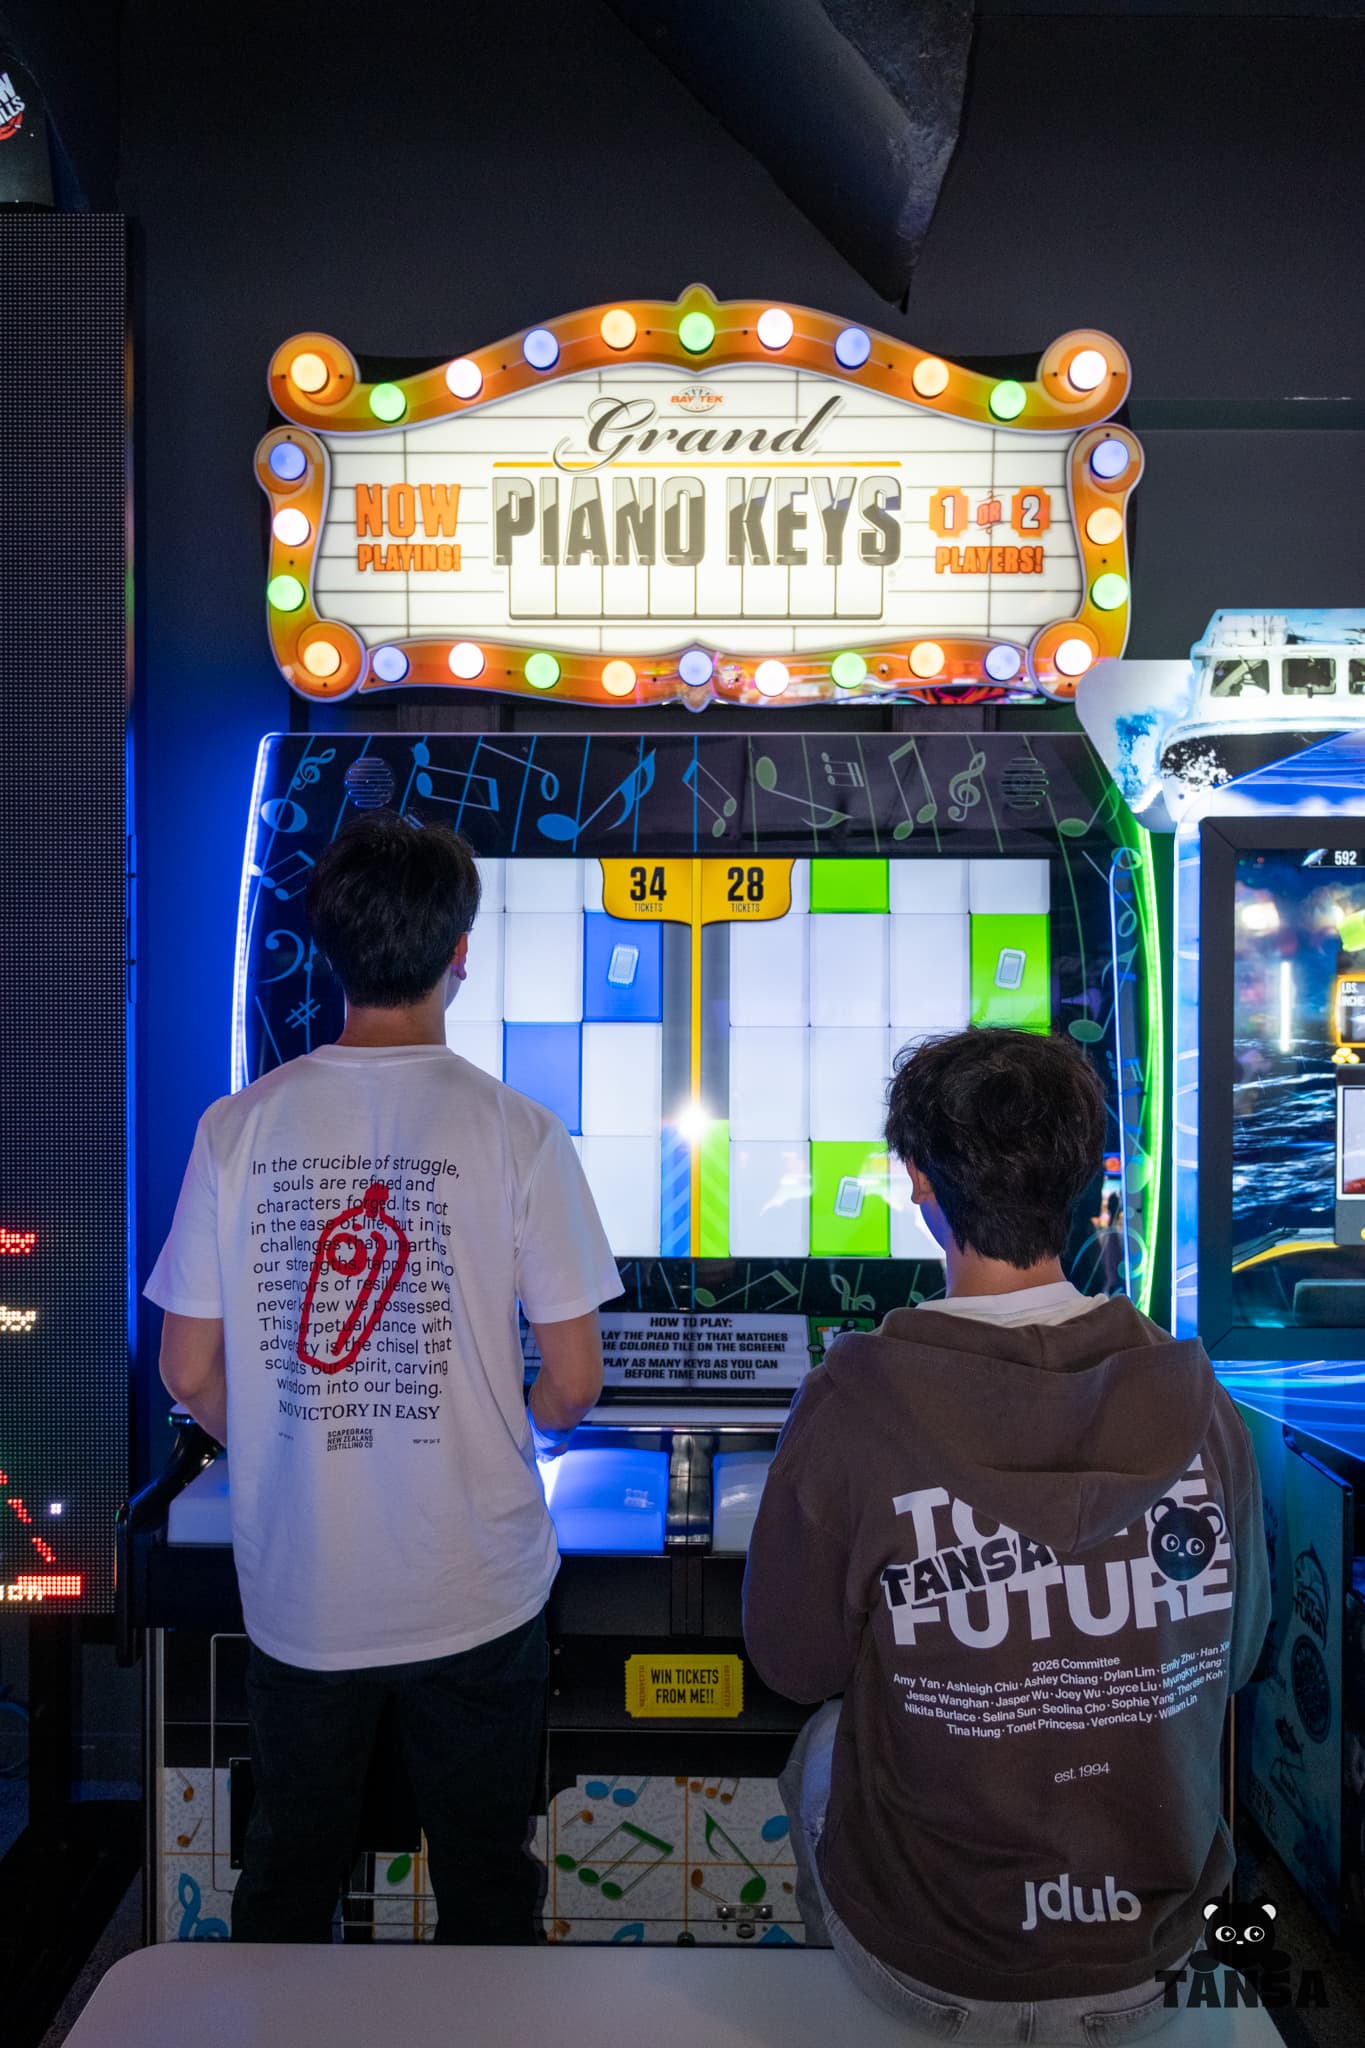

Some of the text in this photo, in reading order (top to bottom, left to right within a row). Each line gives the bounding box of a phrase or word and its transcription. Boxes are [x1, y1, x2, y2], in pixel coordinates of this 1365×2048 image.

[671, 395, 723, 403] BAY TEK
[553, 395, 841, 473] Grand
[354, 483, 461, 537] NOW
[492, 475, 902, 566] PIANO KEYS
[941, 494, 1040, 530] 1 OR 2
[357, 543, 461, 572] PLAYING!
[935, 546, 1044, 574] PLAYERS!
[1334, 851, 1357, 866] 592
[630, 866, 764, 902] 34 28
[634, 902, 760, 913] TICKETS TICKETS
[252, 1154, 460, 1179] In the crucible of struggle,
[273, 1174, 435, 1193] souls are refined and
[257, 1196, 448, 1216] characters forged. Its not
[251, 1216, 452, 1237] in the ease of life, but in its
[260, 1234, 447, 1256] challenges that unearths
[253, 1255, 454, 1276] our strengths, tapping into
[258, 1276, 451, 1294] reservoirs of resilience we
[257, 1296, 453, 1314] never knew we possessed.
[259, 1316, 452, 1337] This perpetual dance with
[650, 1317, 733, 1328] HOW TO PLAY:
[259, 1335, 452, 1356] adversity is the chisel that
[620, 1342, 785, 1352] COLORED TILE ON THE SCREEN!
[624, 1331, 788, 1342] THE PIANO KEY THAT MATCHES
[265, 1357, 448, 1376] sculpts our spirit, carving
[603, 1358, 778, 1369] PLAY AS MANY KEYS AS YOU CAN
[624, 1369, 756, 1380] BEFORE TIME RUNS OUT!
[277, 1377, 443, 1399] wisdom into our being.
[279, 1400, 441, 1421] NO VICTORY IN EASY
[327, 1435, 373, 1445] NEW ZEALAND
[883, 1534, 1056, 1607] TANSA
[889, 1545, 1233, 1649] FUTURE
[893, 1645, 1218, 1695] Amy Yan Ashleigh Chiu Ashley Chiang Dylan Lim Emily Zhu Han
[1032, 1656, 1120, 1673] 2026 Committee
[651, 1669, 719, 1684] WIN TICKETS
[906, 1658, 1222, 1709] Jesse Wanghan Jasper Wu Joey Wu Joyce Liu Kang
[656, 1688, 714, 1704] FROM ME!!
[904, 1670, 1224, 1723] Nikita Burlace Selina Sun Seolina Cho Sophie Yang Therese Koh
[946, 1694, 1198, 1739] Tina Hung Tonet Princesa Veronica Ly William Lin
[1054, 1762, 1110, 1783] est. 1994
